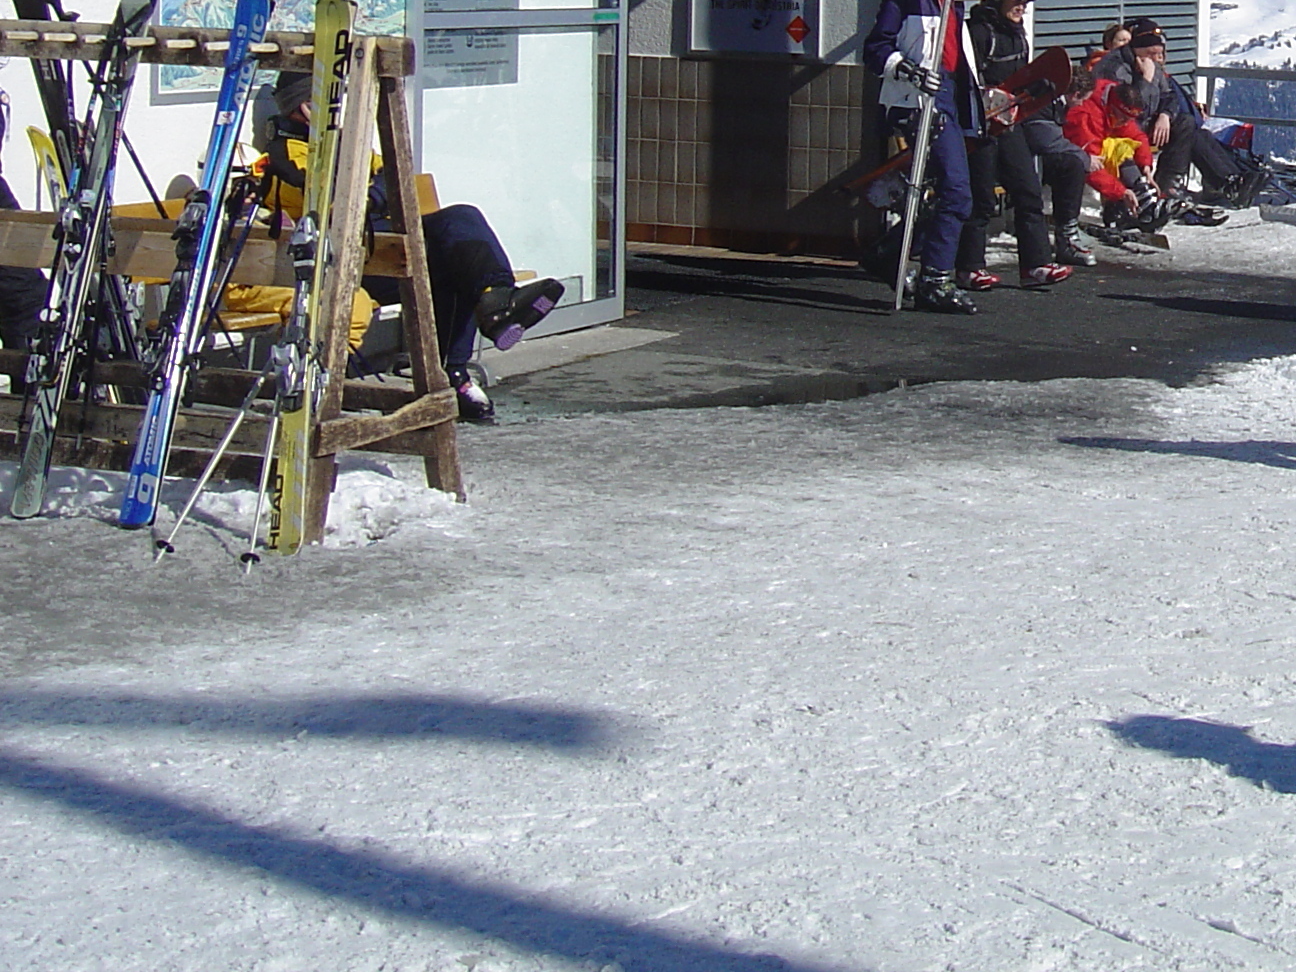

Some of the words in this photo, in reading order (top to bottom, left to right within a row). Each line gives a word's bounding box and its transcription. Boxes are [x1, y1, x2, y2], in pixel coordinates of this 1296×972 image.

[234, 13, 265, 111] ATOIC
[327, 29, 349, 131] HEAD
[144, 415, 158, 468] ATOMIC
[269, 474, 284, 550] HEAD
